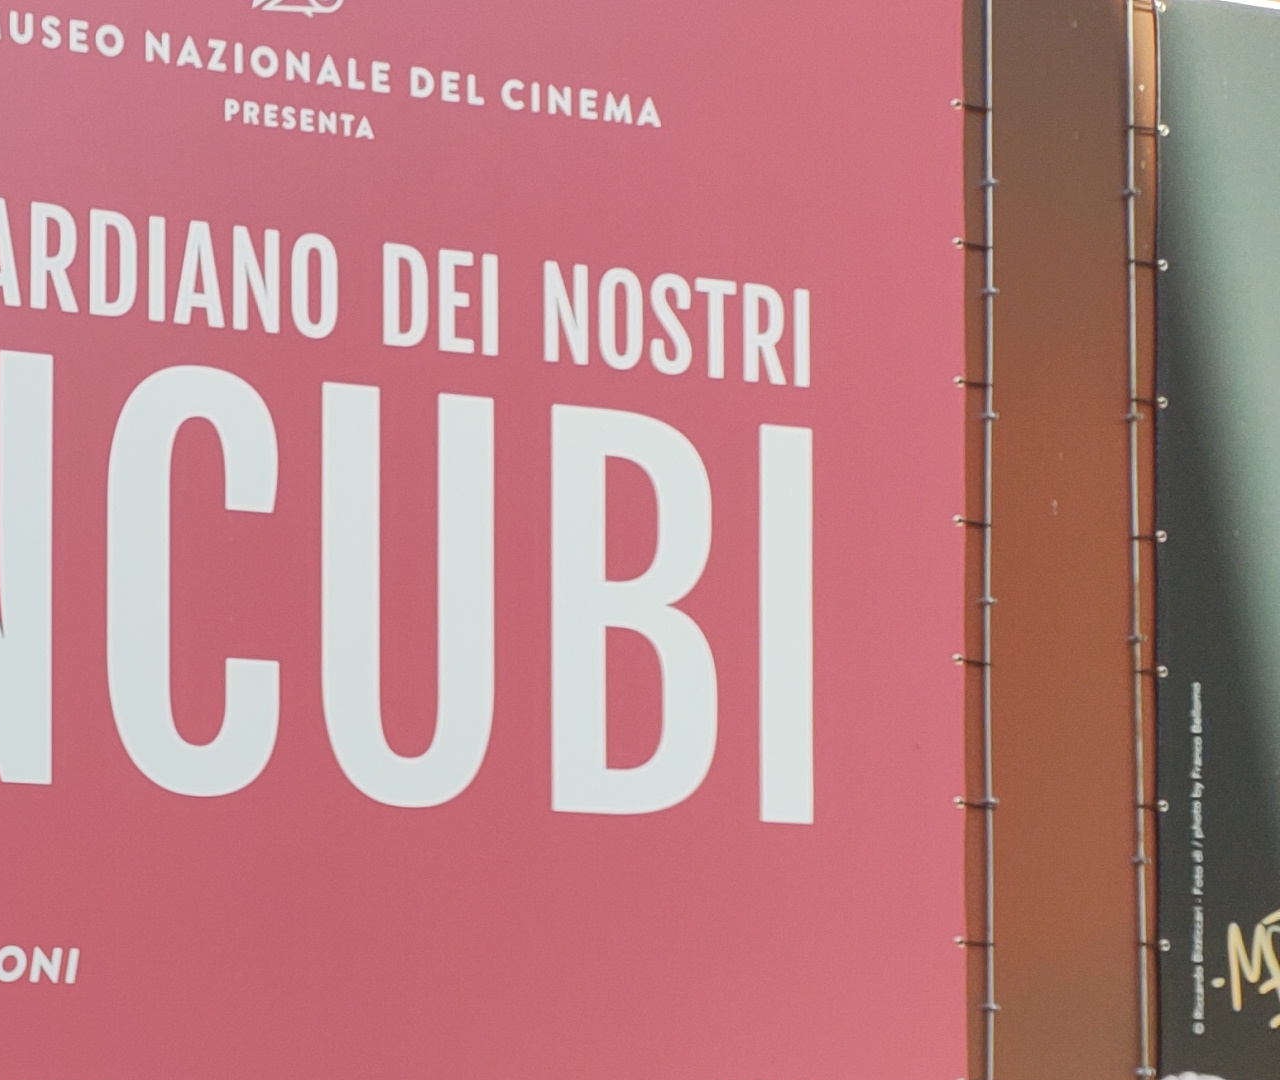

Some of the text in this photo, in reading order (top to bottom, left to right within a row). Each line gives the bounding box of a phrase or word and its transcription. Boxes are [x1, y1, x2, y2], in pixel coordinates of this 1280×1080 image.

[145, 29, 391, 94] NAZIONALE
[410, 66, 485, 106] DEL
[501, 79, 662, 128] CINEMA
[224, 98, 375, 140] PRESENTA
[382, 242, 499, 357] DEI
[543, 260, 811, 388] NOSTRI
